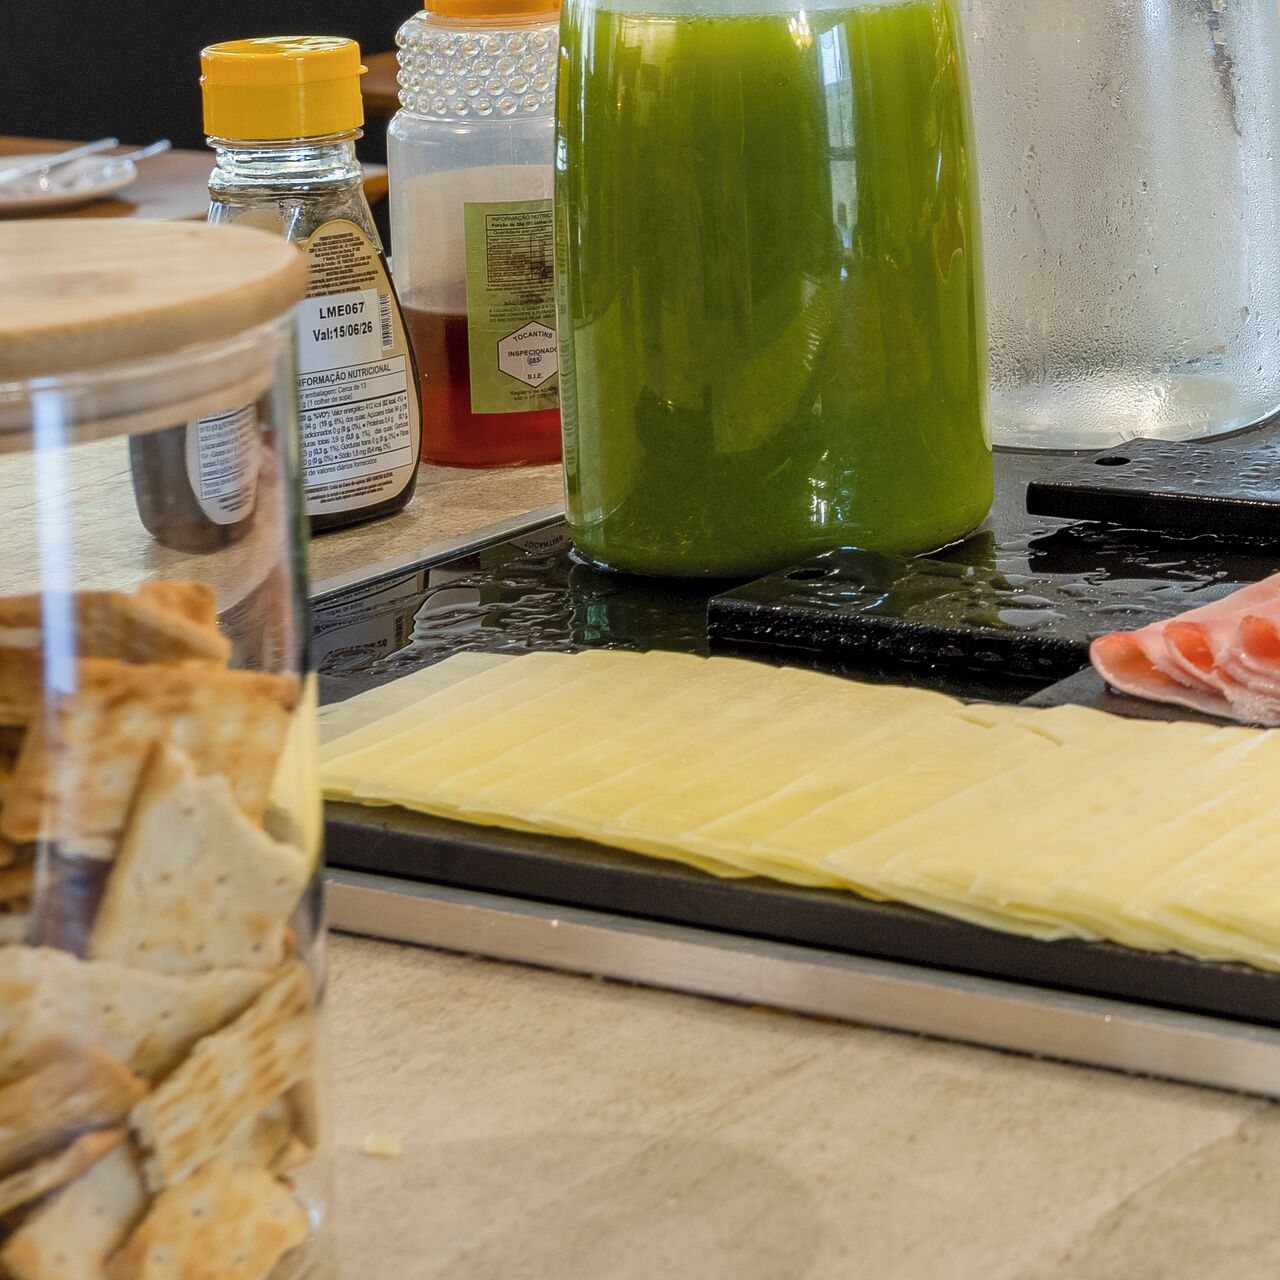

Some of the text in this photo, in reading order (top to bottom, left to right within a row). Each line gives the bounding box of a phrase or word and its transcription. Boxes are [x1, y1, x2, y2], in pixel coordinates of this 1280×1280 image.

[320, 302, 364, 319] LME067
[313, 321, 372, 341] Val:15/06/26
[513, 330, 553, 343] TOCANTINS
[348, 363, 391, 379] NUTRICIONAL
[338, 385, 352, 393] Cerca
[317, 465, 336, 475] valores
